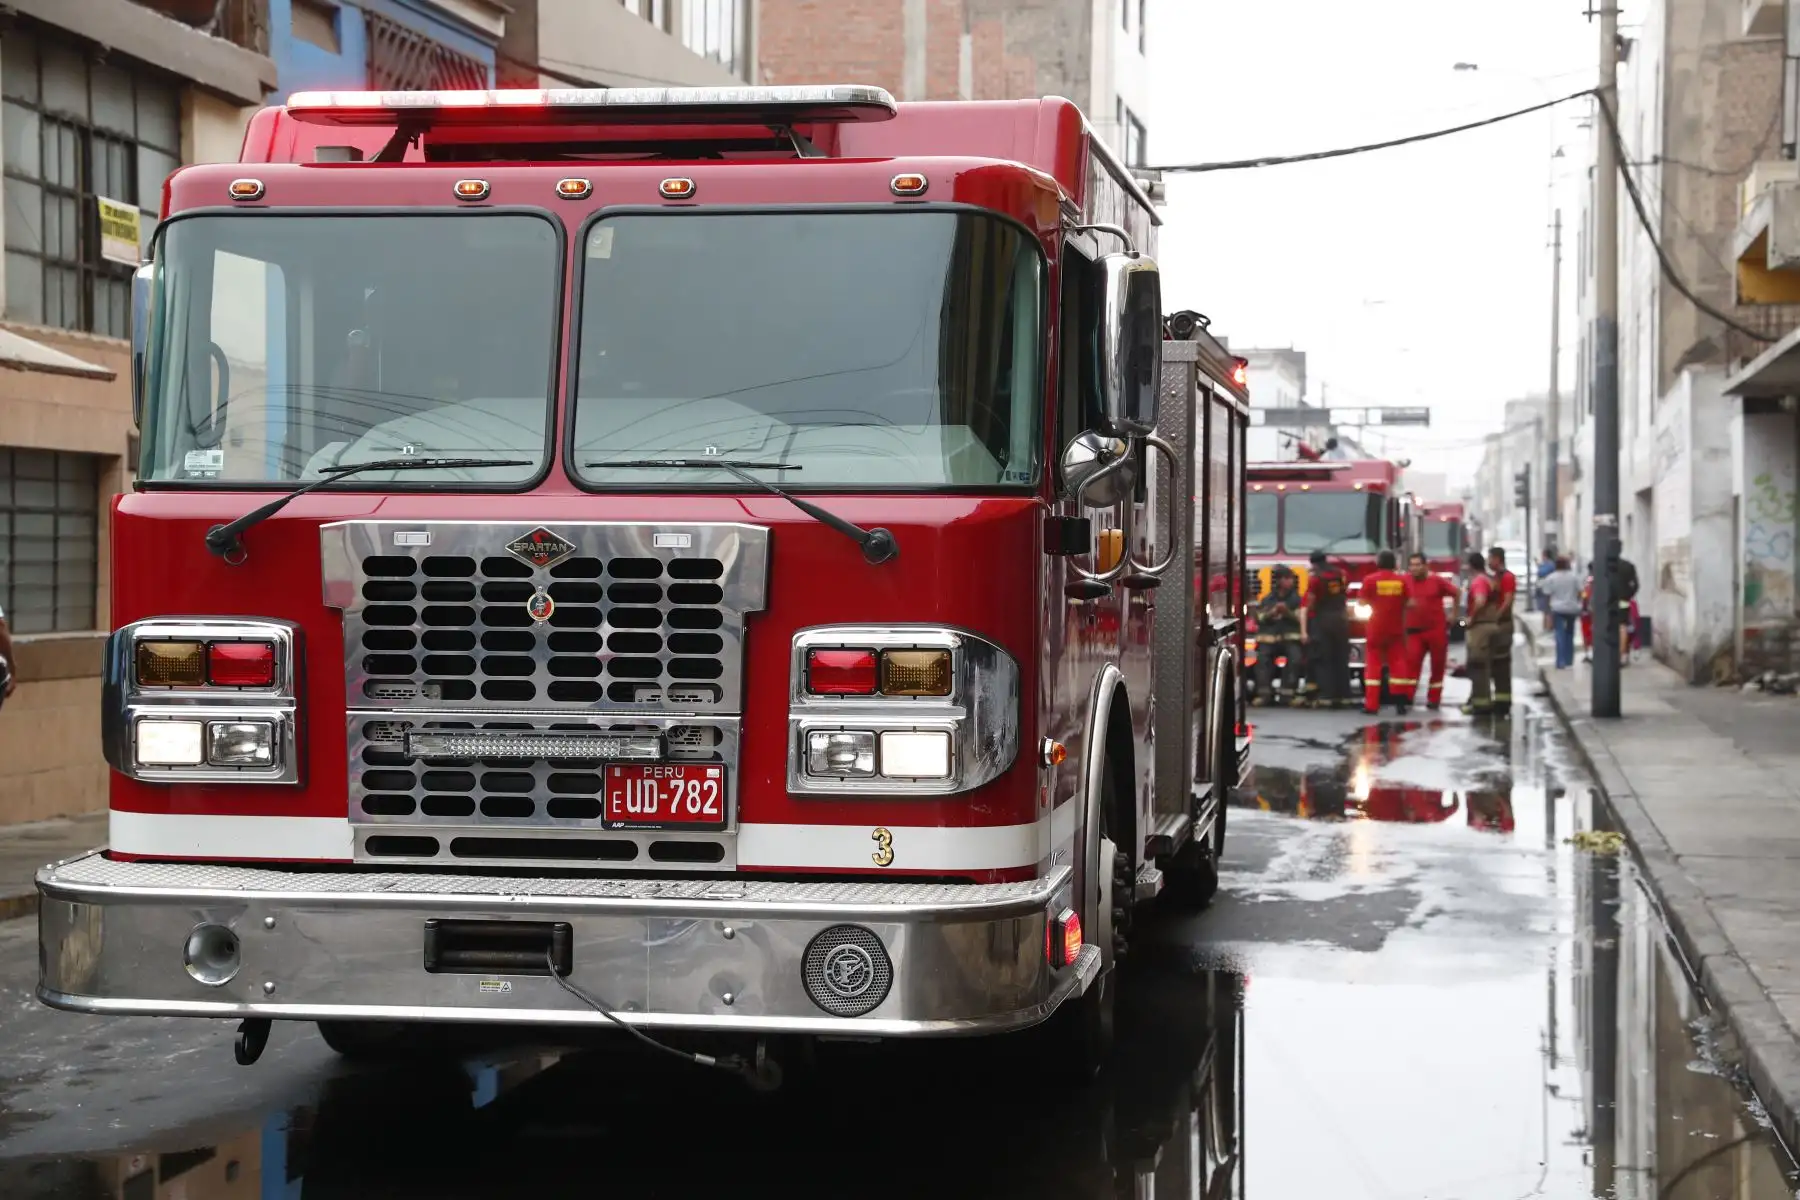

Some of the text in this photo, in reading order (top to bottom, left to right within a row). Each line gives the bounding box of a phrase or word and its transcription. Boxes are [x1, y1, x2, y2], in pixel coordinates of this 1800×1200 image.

[513, 542, 567, 552] SPARTAN
[643, 766, 685, 778] PERU
[872, 827, 894, 867] 3
